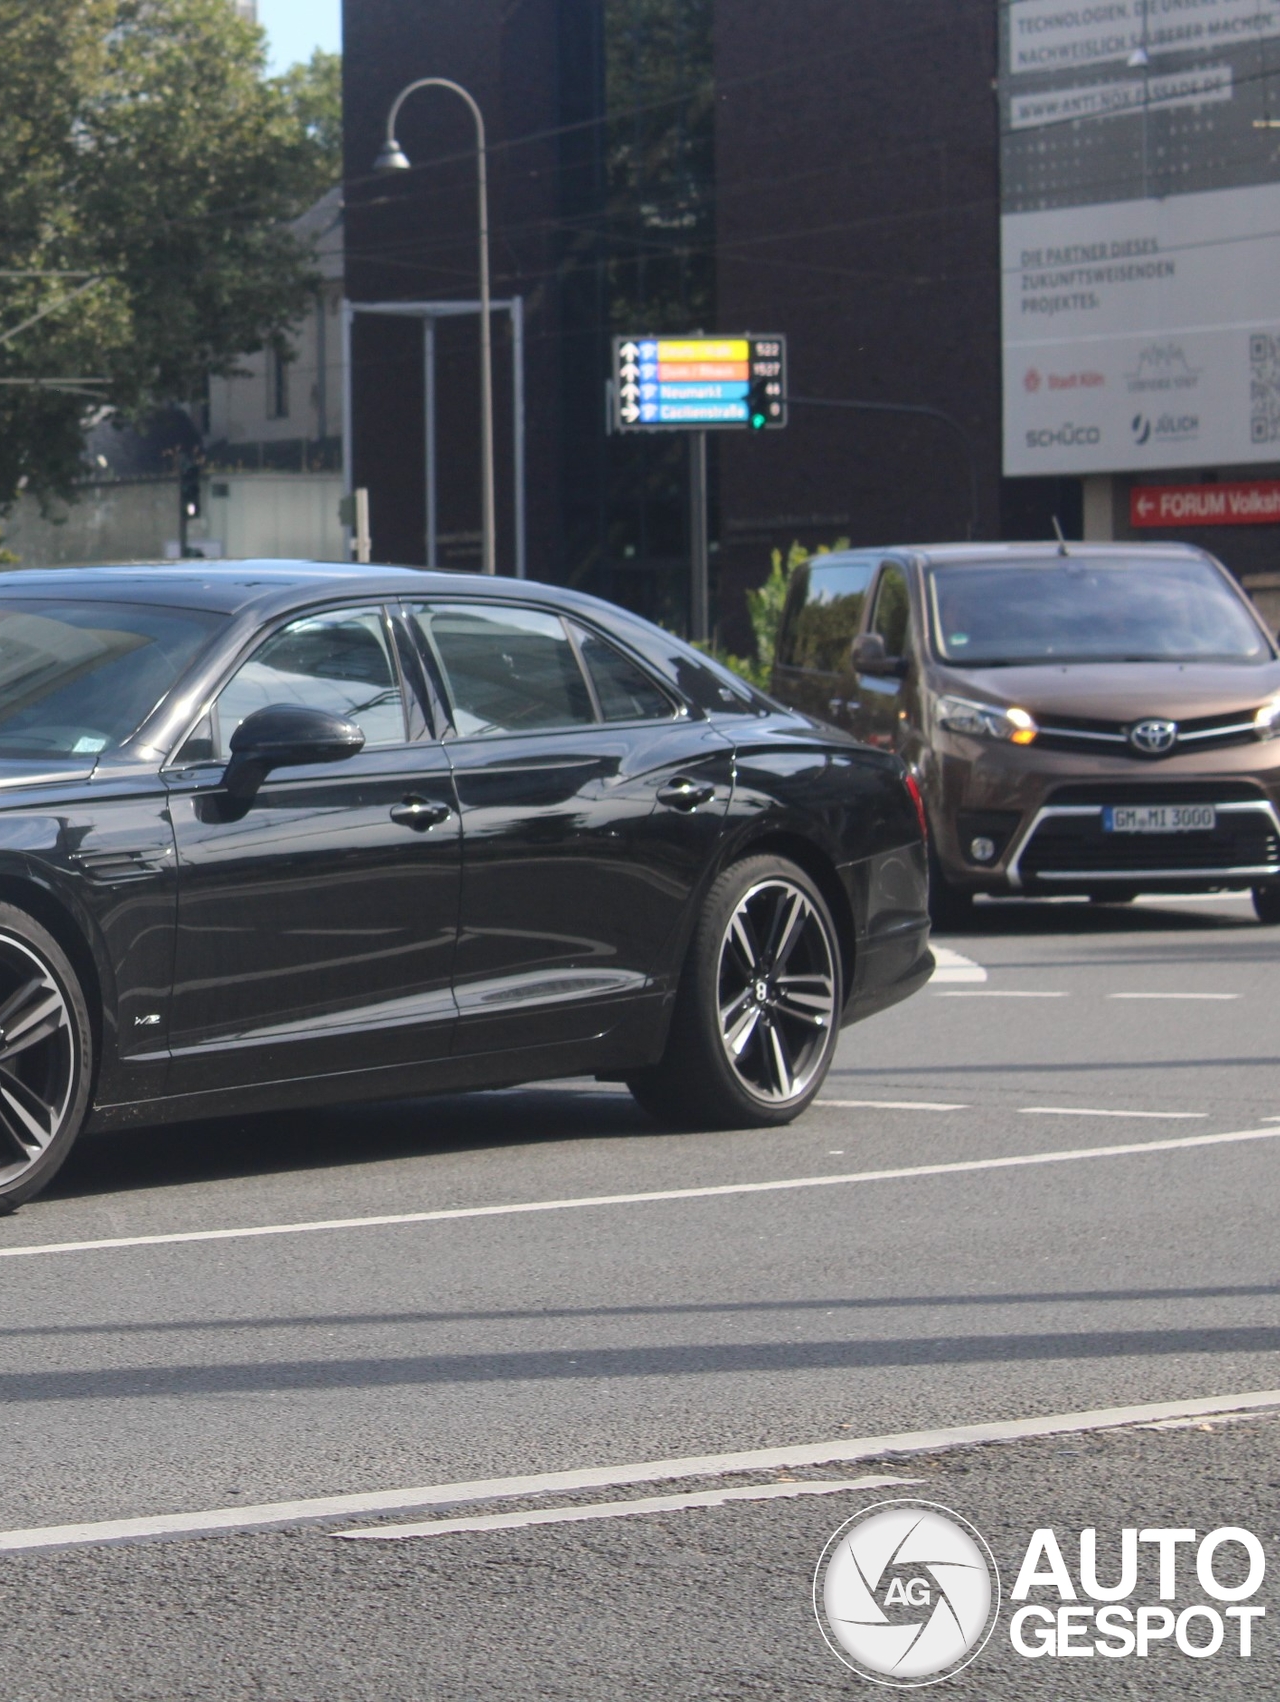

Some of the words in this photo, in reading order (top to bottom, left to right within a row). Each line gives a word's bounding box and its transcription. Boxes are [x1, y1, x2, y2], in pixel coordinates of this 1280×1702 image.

[1046, 242, 1107, 265] PARTNER
[1111, 237, 1158, 260] DIESES
[660, 383, 722, 399] Neumarkt
[1025, 422, 1100, 448] SCHÜCO
[1160, 491, 1225, 518] FORUM
[1172, 808, 1212, 826] 3000
